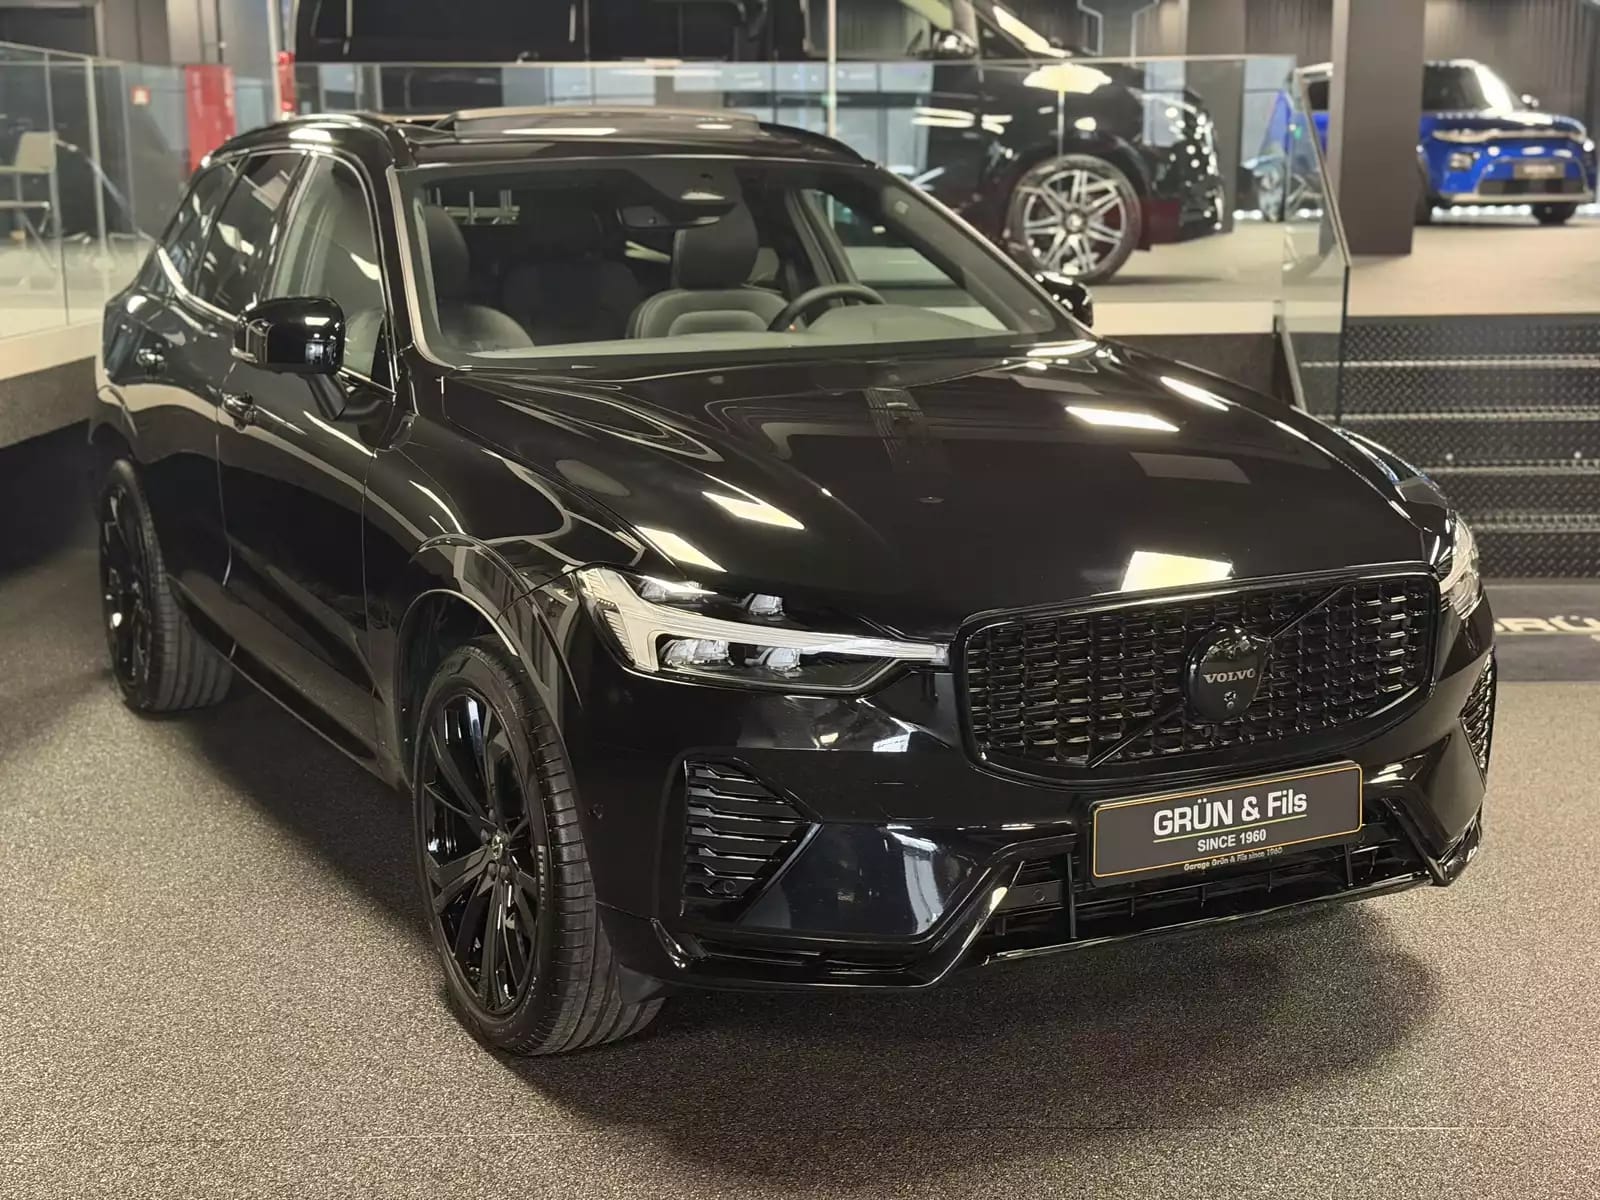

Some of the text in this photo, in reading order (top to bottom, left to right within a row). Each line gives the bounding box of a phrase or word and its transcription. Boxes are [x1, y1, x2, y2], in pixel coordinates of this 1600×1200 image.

[1493, 615, 1600, 634] RÜ
[1203, 668, 1255, 683] VOLVO
[1153, 789, 1307, 836] GRÜN & Fils
[1197, 829, 1266, 852] SINCE 1960
[1184, 861, 1210, 871] Garage
[1211, 858, 1229, 866] Grün
[1237, 854, 1248, 862] Fils
[1248, 851, 1265, 860] since
[1266, 847, 1283, 856] 1960
